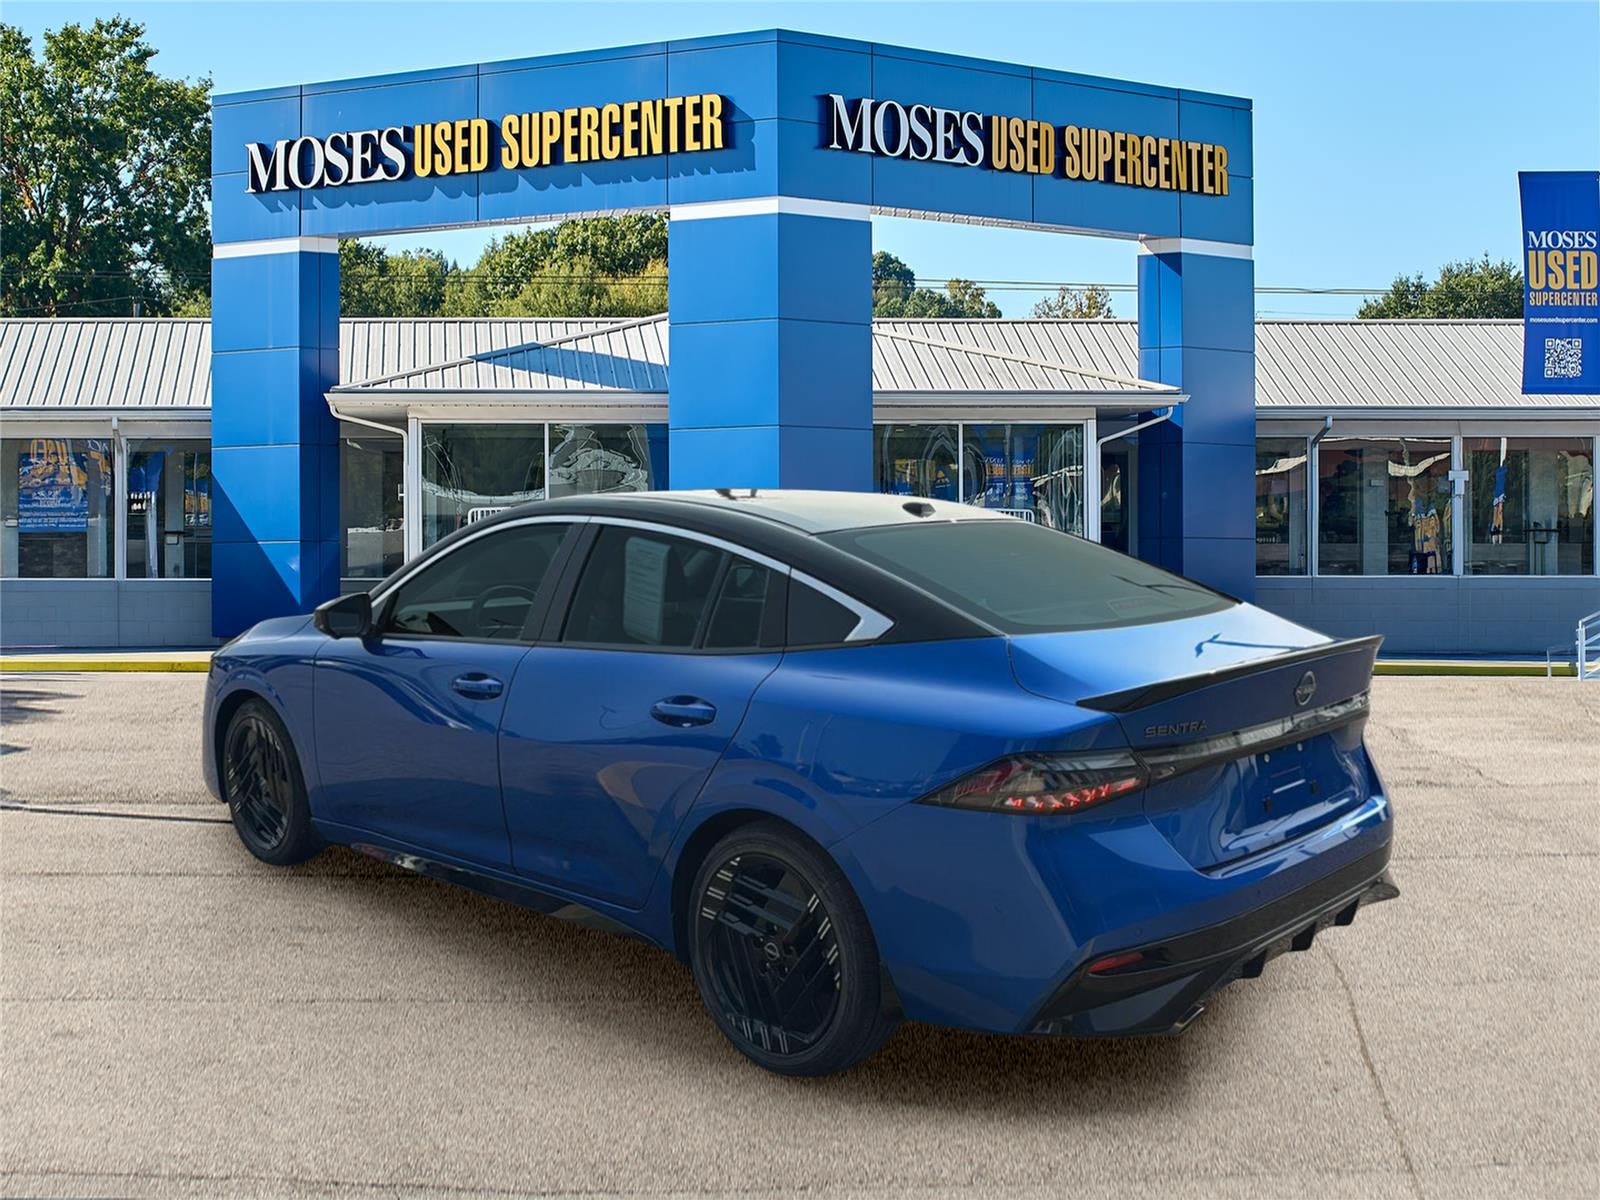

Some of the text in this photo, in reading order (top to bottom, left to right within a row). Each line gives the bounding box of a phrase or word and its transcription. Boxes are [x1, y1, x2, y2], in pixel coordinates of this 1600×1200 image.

[244, 93, 724, 193] MOSES USED SUPERCENTER
[829, 93, 1229, 196] MOSES USED SUPERCENTER
[1527, 230, 1598, 249] MOSES
[1528, 250, 1598, 290] USED
[1529, 291, 1598, 306] SUPERCENTER
[1529, 316, 1598, 324] mosesusedsupercenter.com
[1144, 720, 1208, 738] SENTRA
